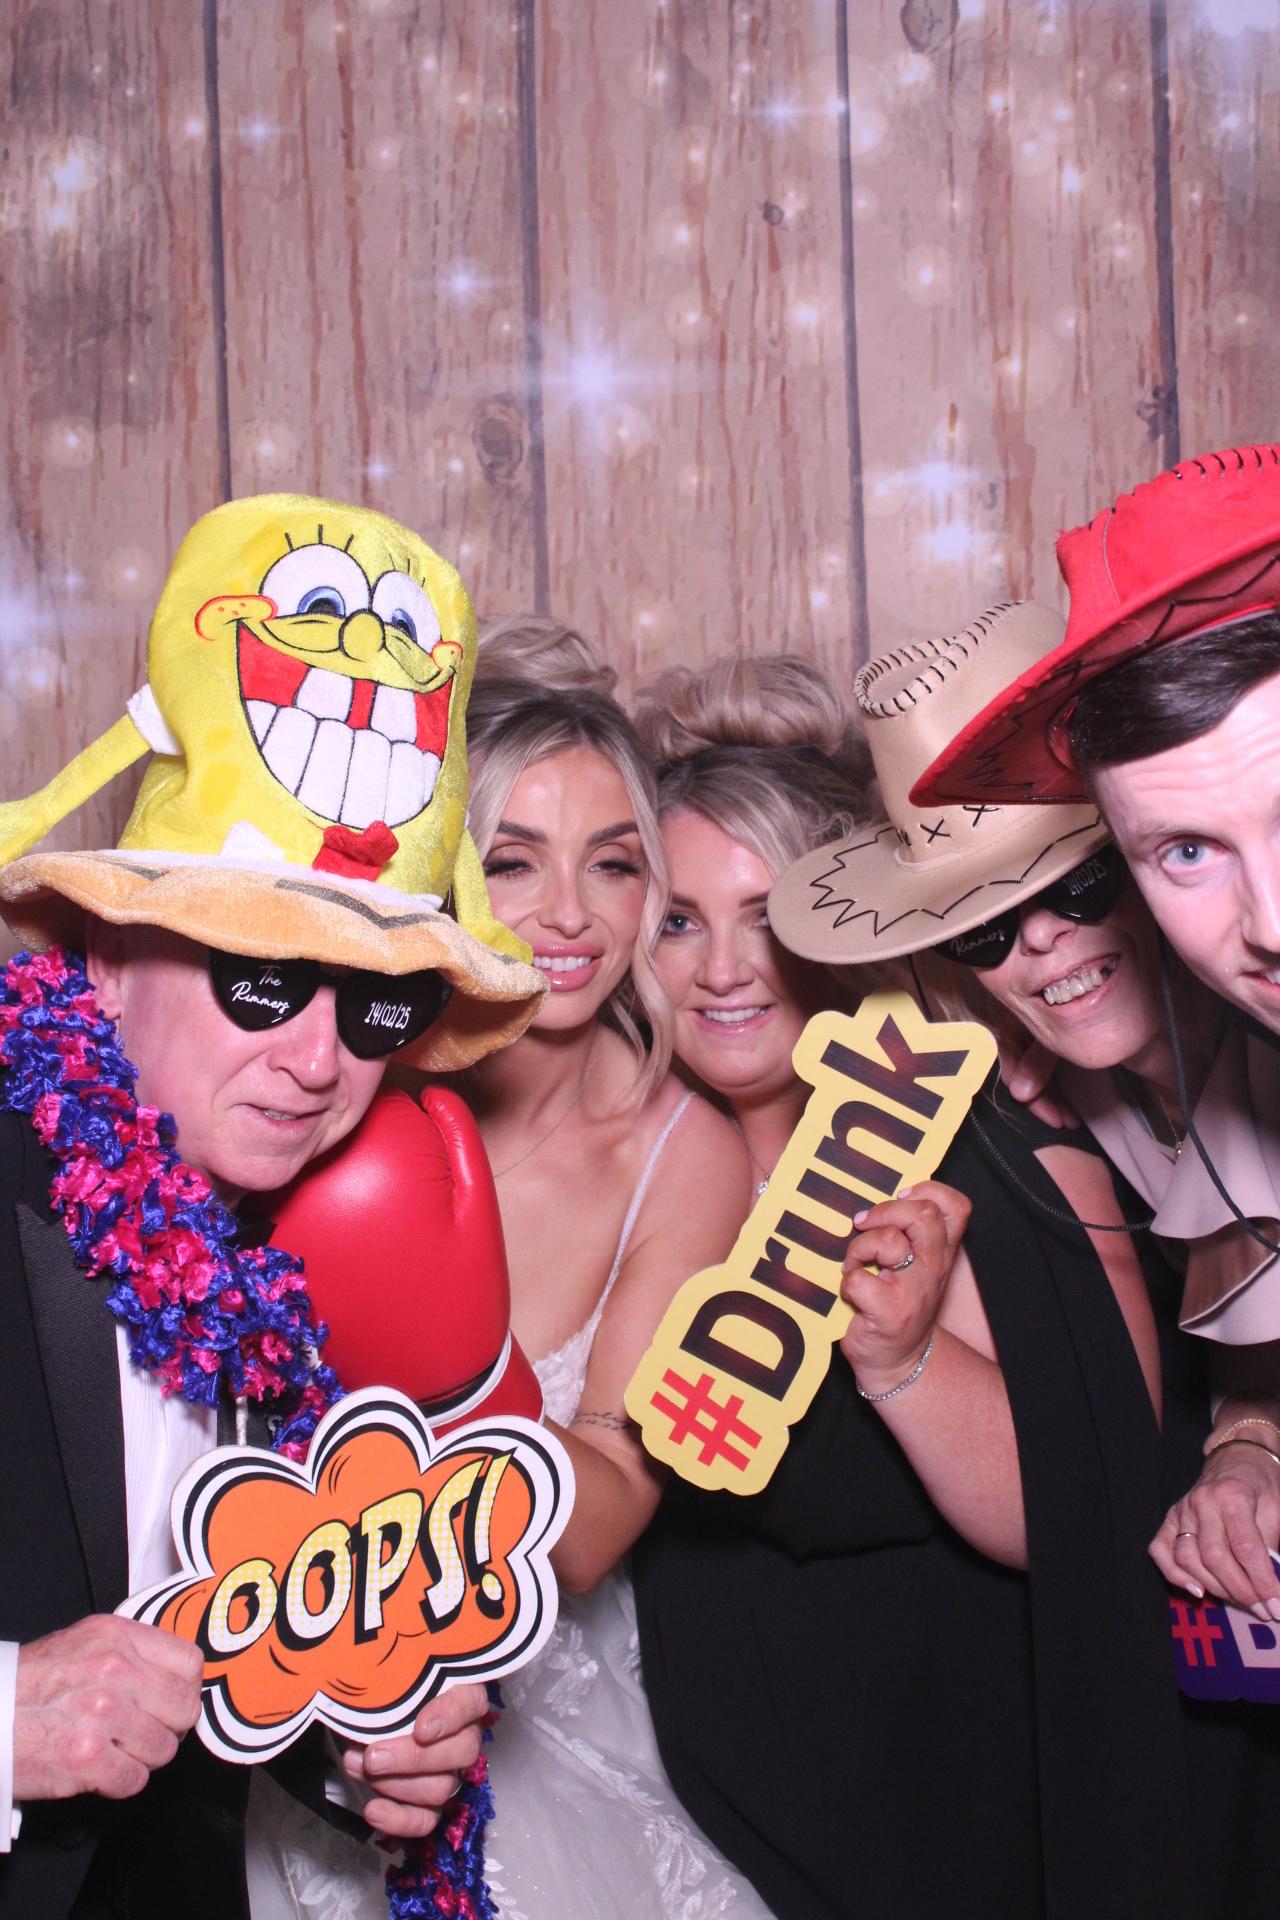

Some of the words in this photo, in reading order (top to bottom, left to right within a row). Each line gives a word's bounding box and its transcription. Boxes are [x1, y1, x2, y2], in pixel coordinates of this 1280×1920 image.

[258, 965, 282, 987] The
[231, 981, 290, 1014] Rimmers
[364, 1000, 411, 1030] 14/02/25
[649, 1013, 970, 1472] #Drunk
[199, 1447, 517, 1661] OOPS!
